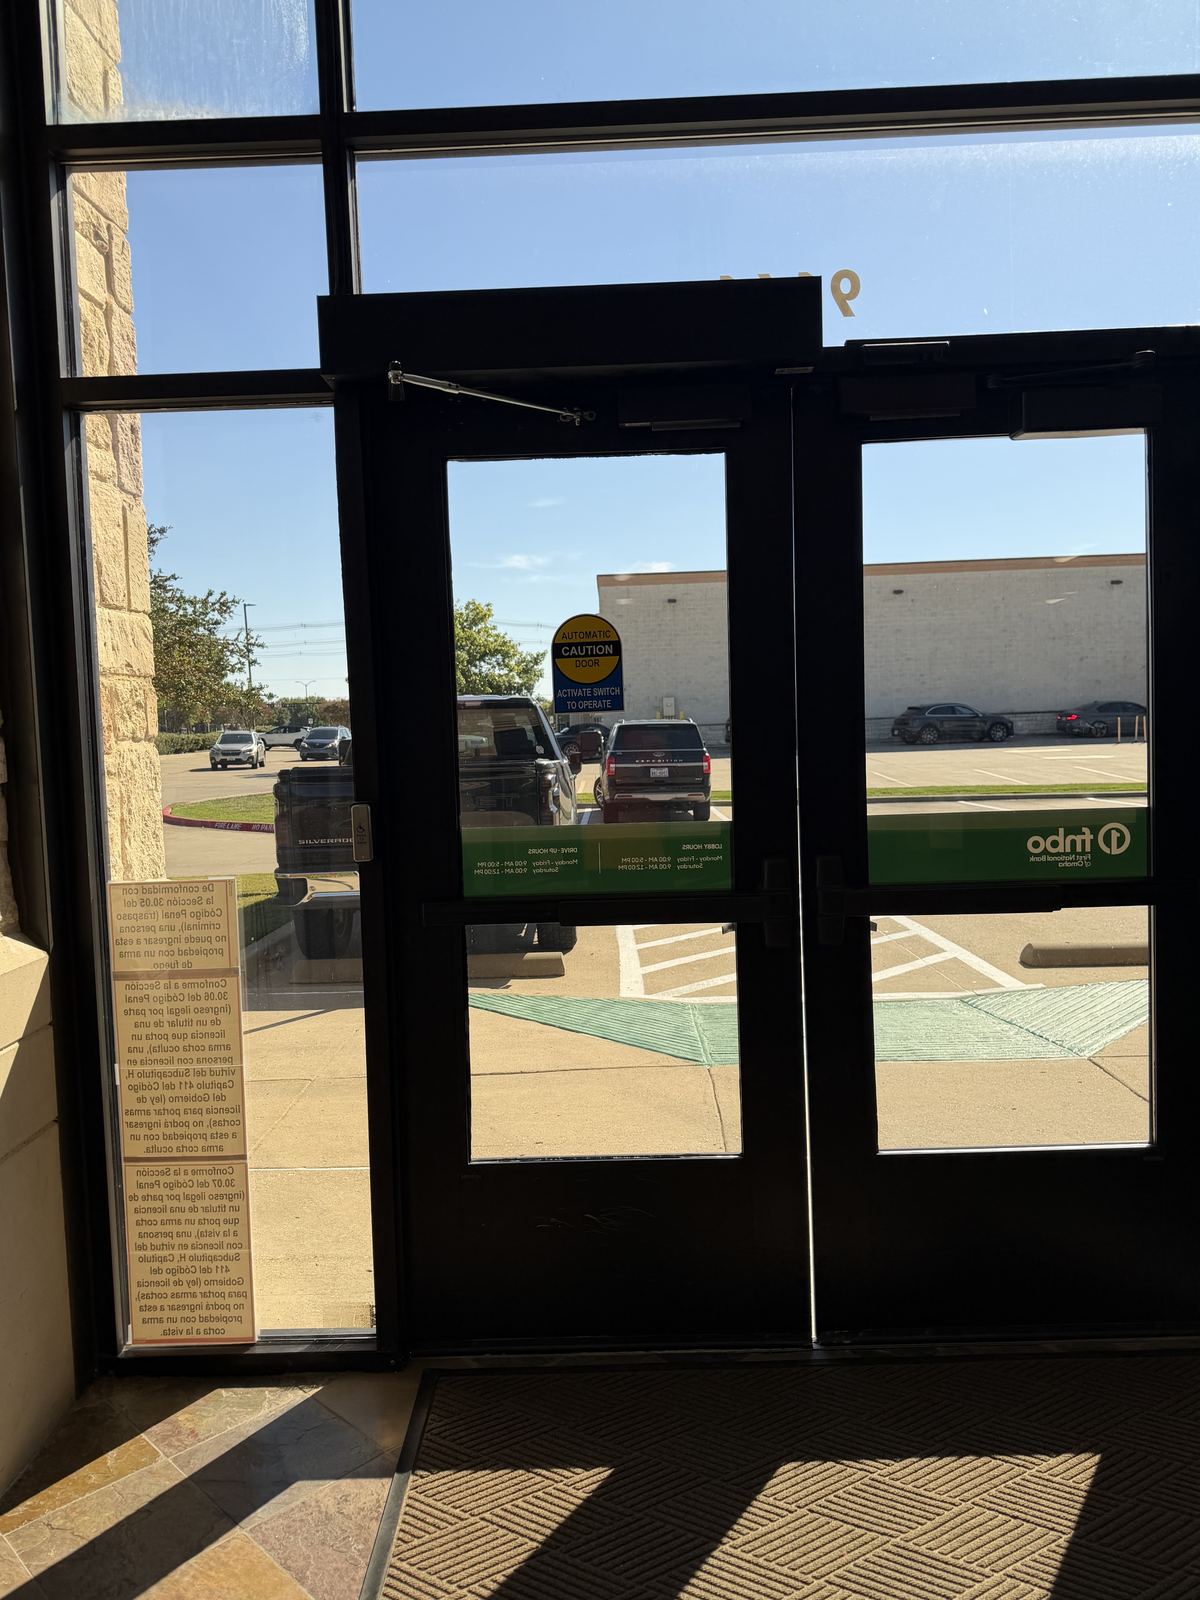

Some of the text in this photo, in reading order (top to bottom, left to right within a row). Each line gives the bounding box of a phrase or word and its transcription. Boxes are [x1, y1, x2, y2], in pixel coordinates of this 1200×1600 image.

[562, 630, 610, 640] AUTOMATIC
[562, 645, 612, 656] CAUTION
[557, 687, 620, 697] ACTIVATE SWITCH
[578, 700, 612, 708] OPERATE
